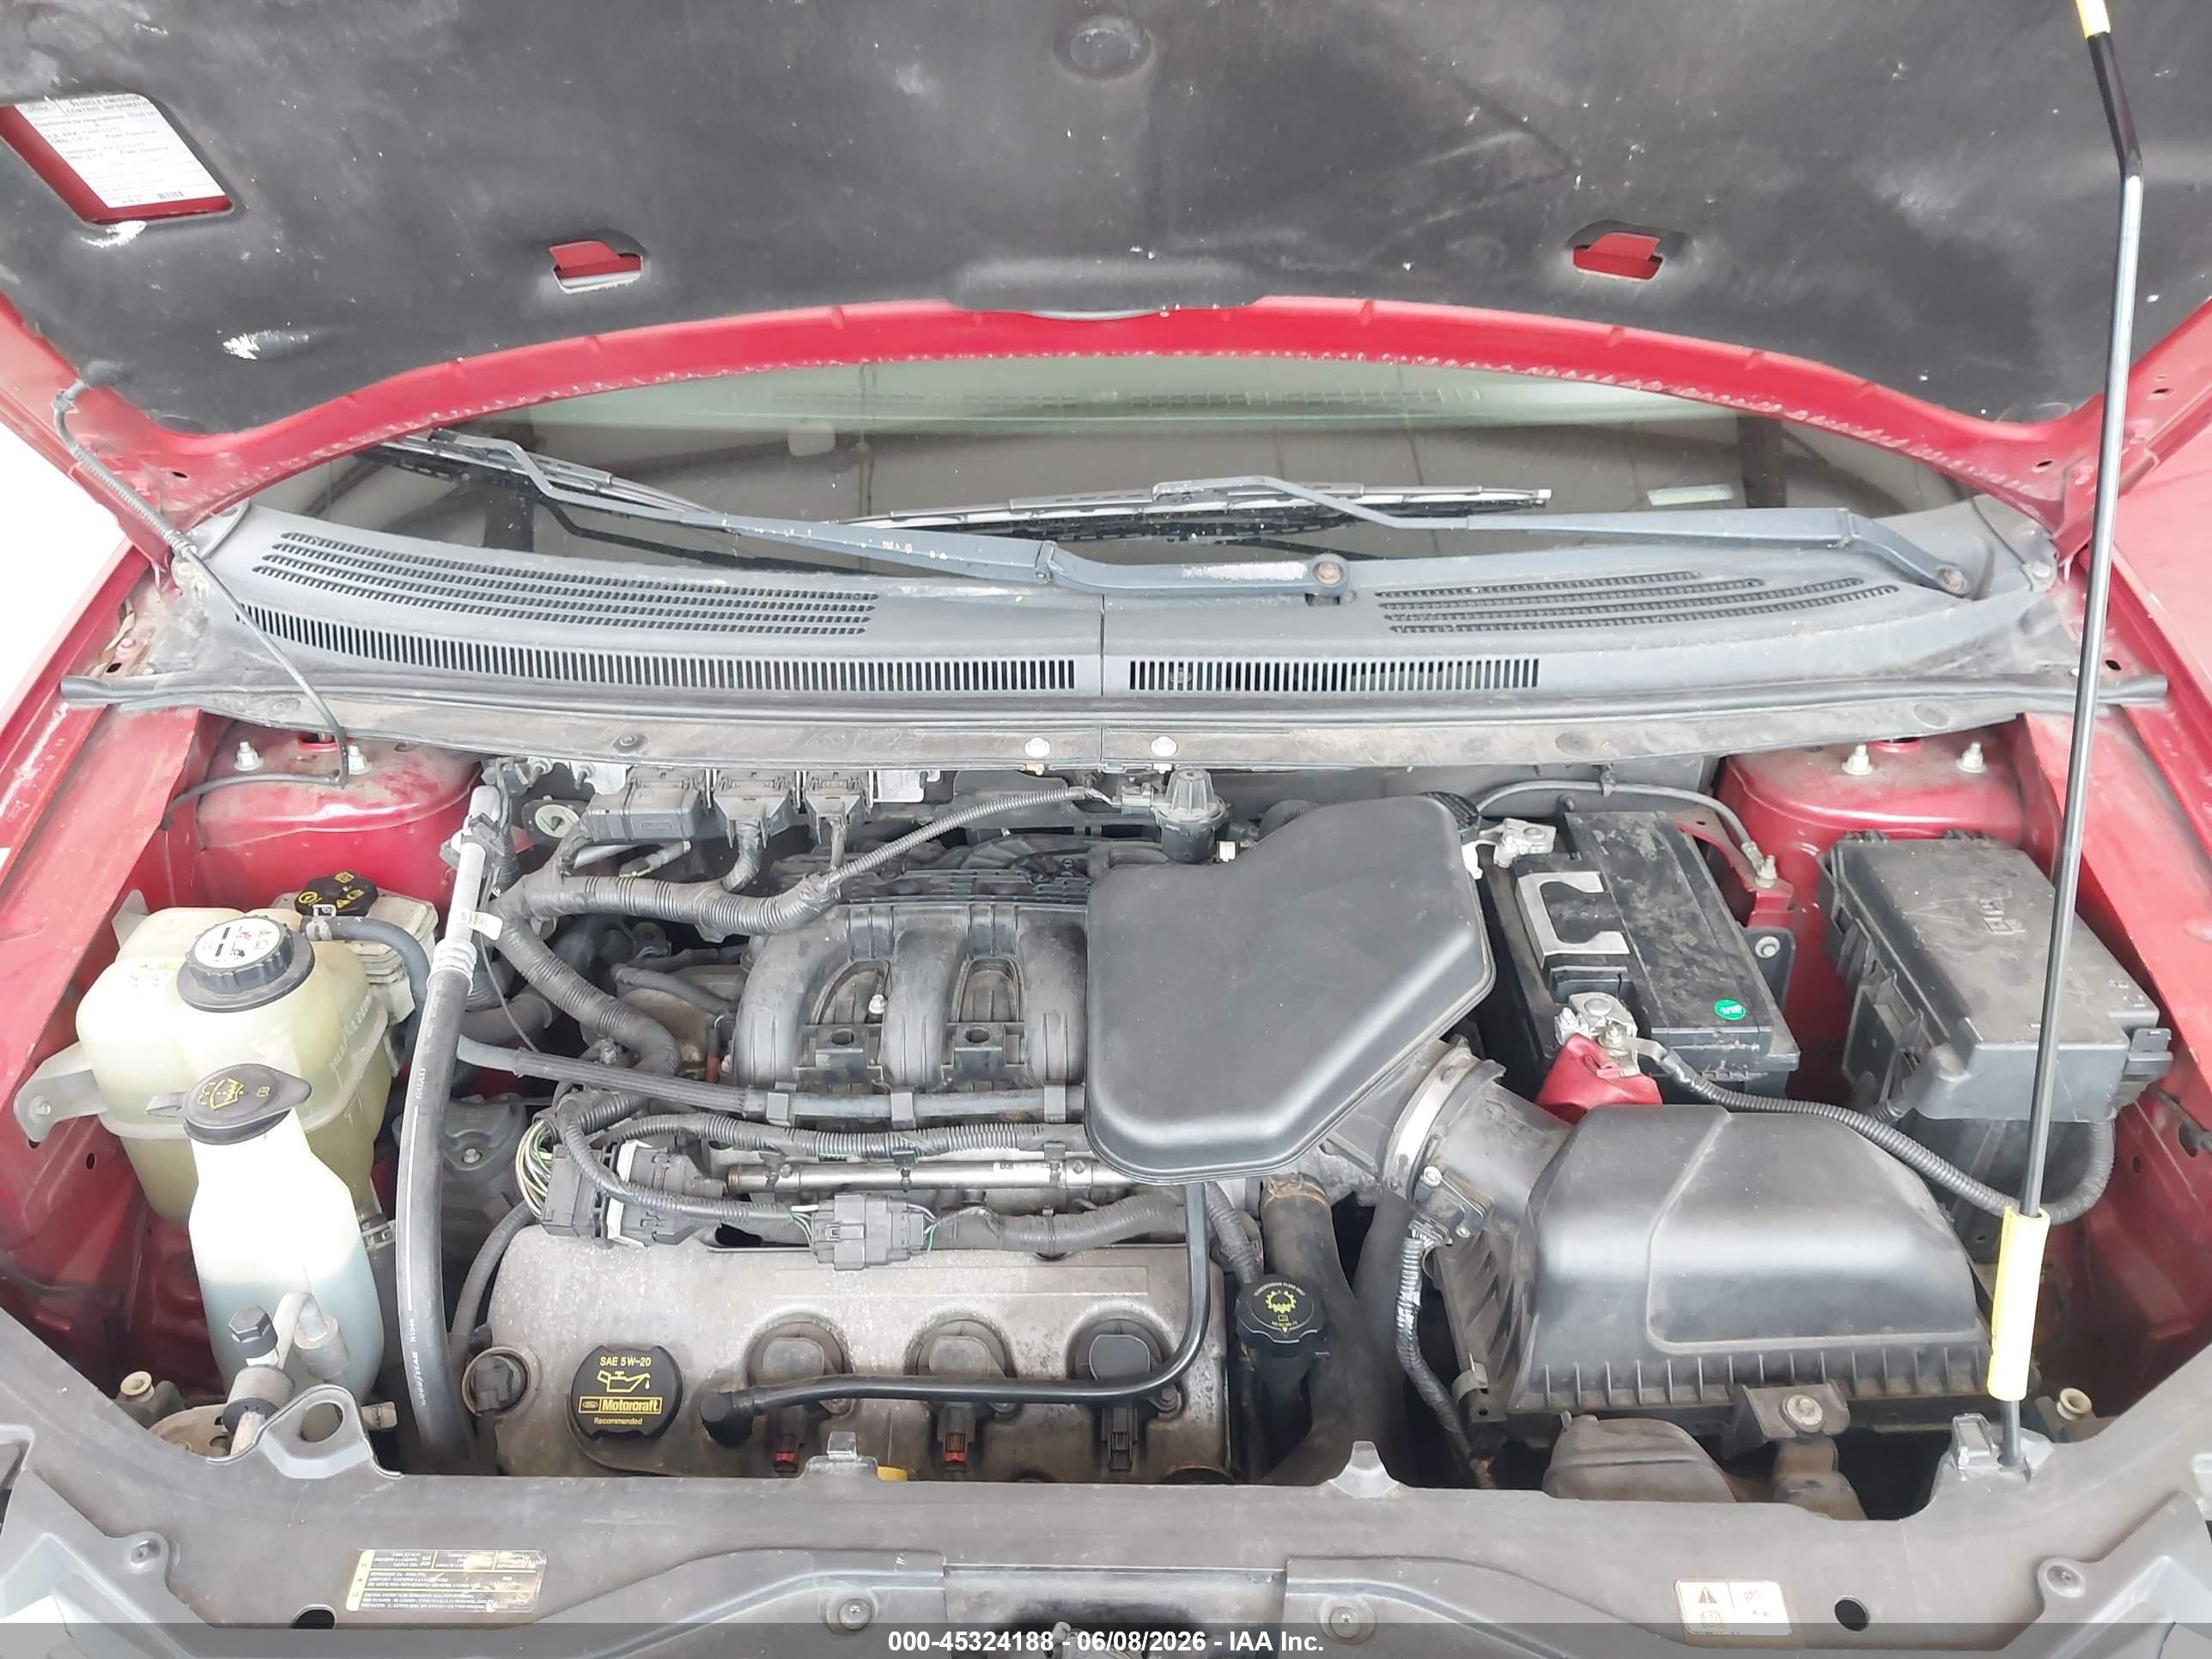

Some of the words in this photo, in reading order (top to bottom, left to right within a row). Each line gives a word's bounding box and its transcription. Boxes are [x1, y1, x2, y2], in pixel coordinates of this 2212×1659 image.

[599, 1356, 618, 1367] SAE
[620, 1356, 652, 1367] 5W-20
[412, 1352, 427, 1406] GOODYEAR
[602, 1399, 658, 1413] Motorcraft
[593, 1417, 643, 1425] Recommended
